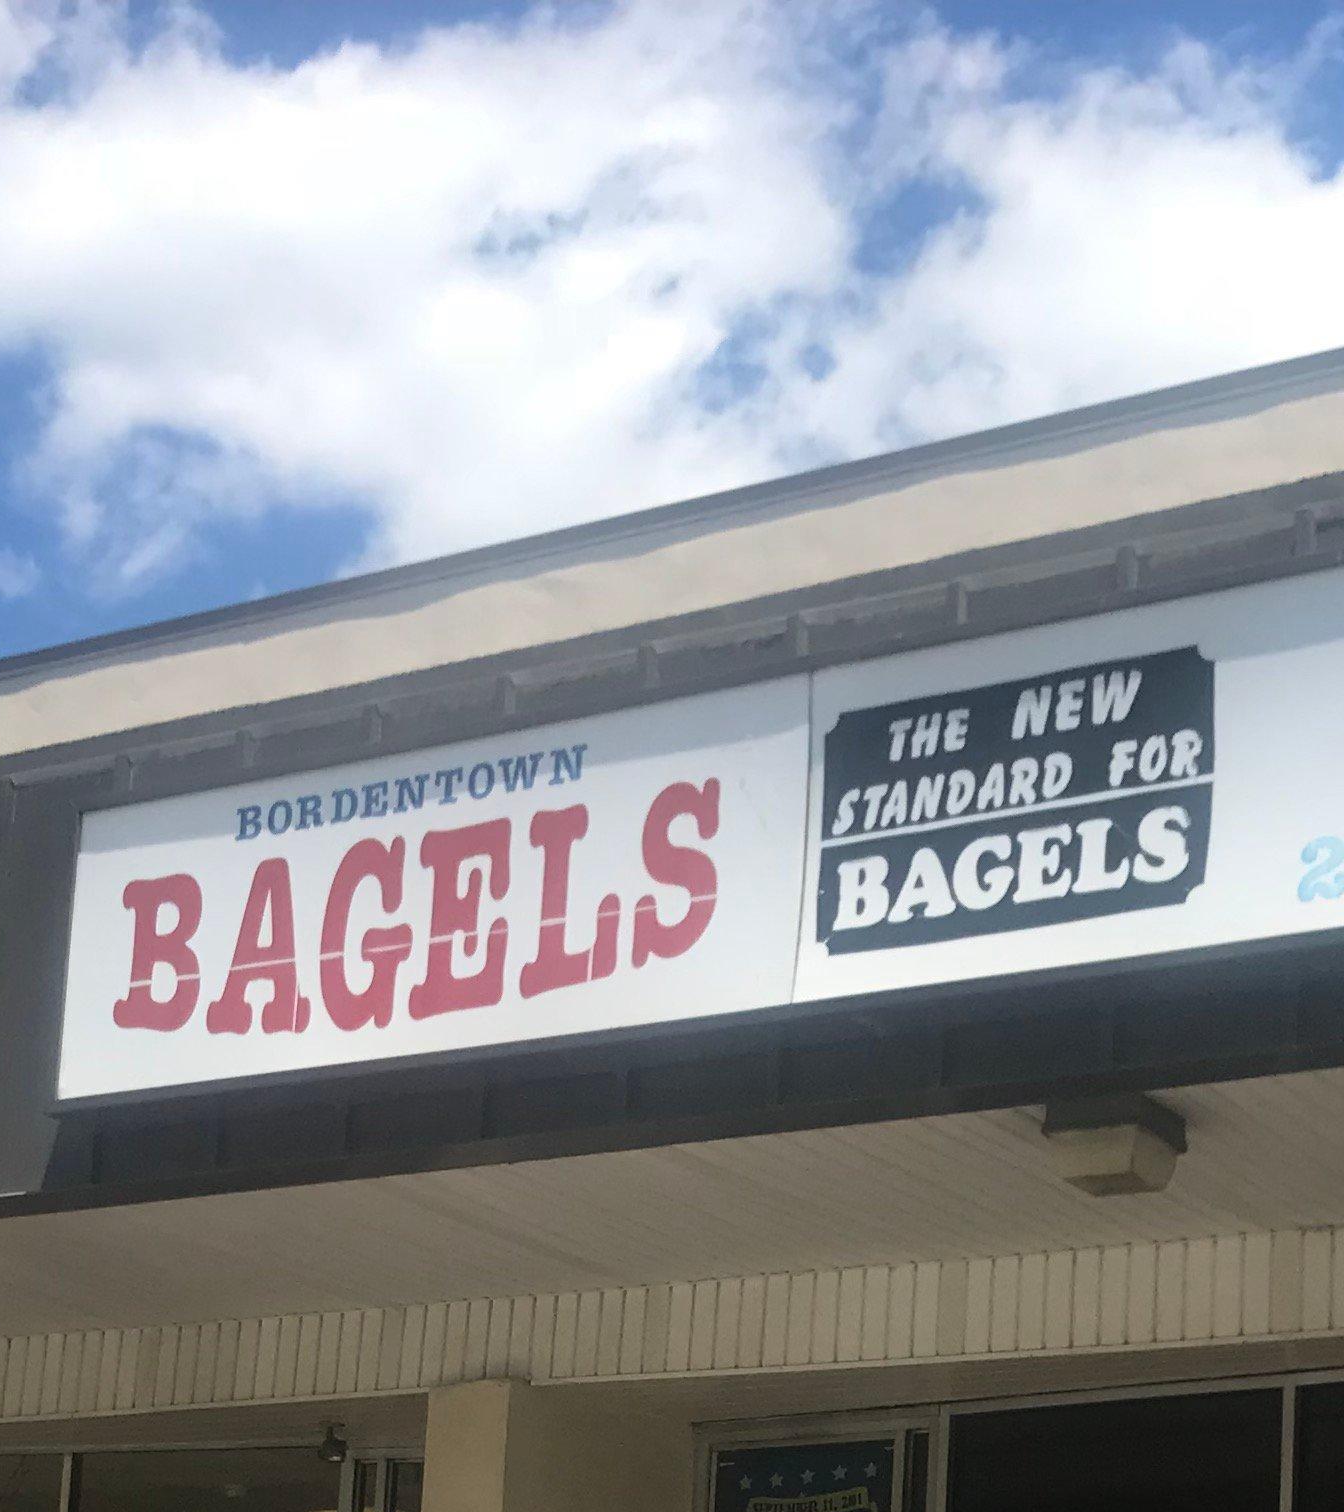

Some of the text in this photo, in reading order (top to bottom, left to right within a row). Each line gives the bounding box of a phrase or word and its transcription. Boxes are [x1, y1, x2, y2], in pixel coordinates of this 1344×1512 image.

[887, 670, 1143, 763] THE NEW
[235, 743, 589, 842] BORDENTOWN
[831, 730, 1204, 835] STANDARD FOR
[112, 776, 722, 1036] BAGELS
[831, 806, 1192, 933] BAGELS
